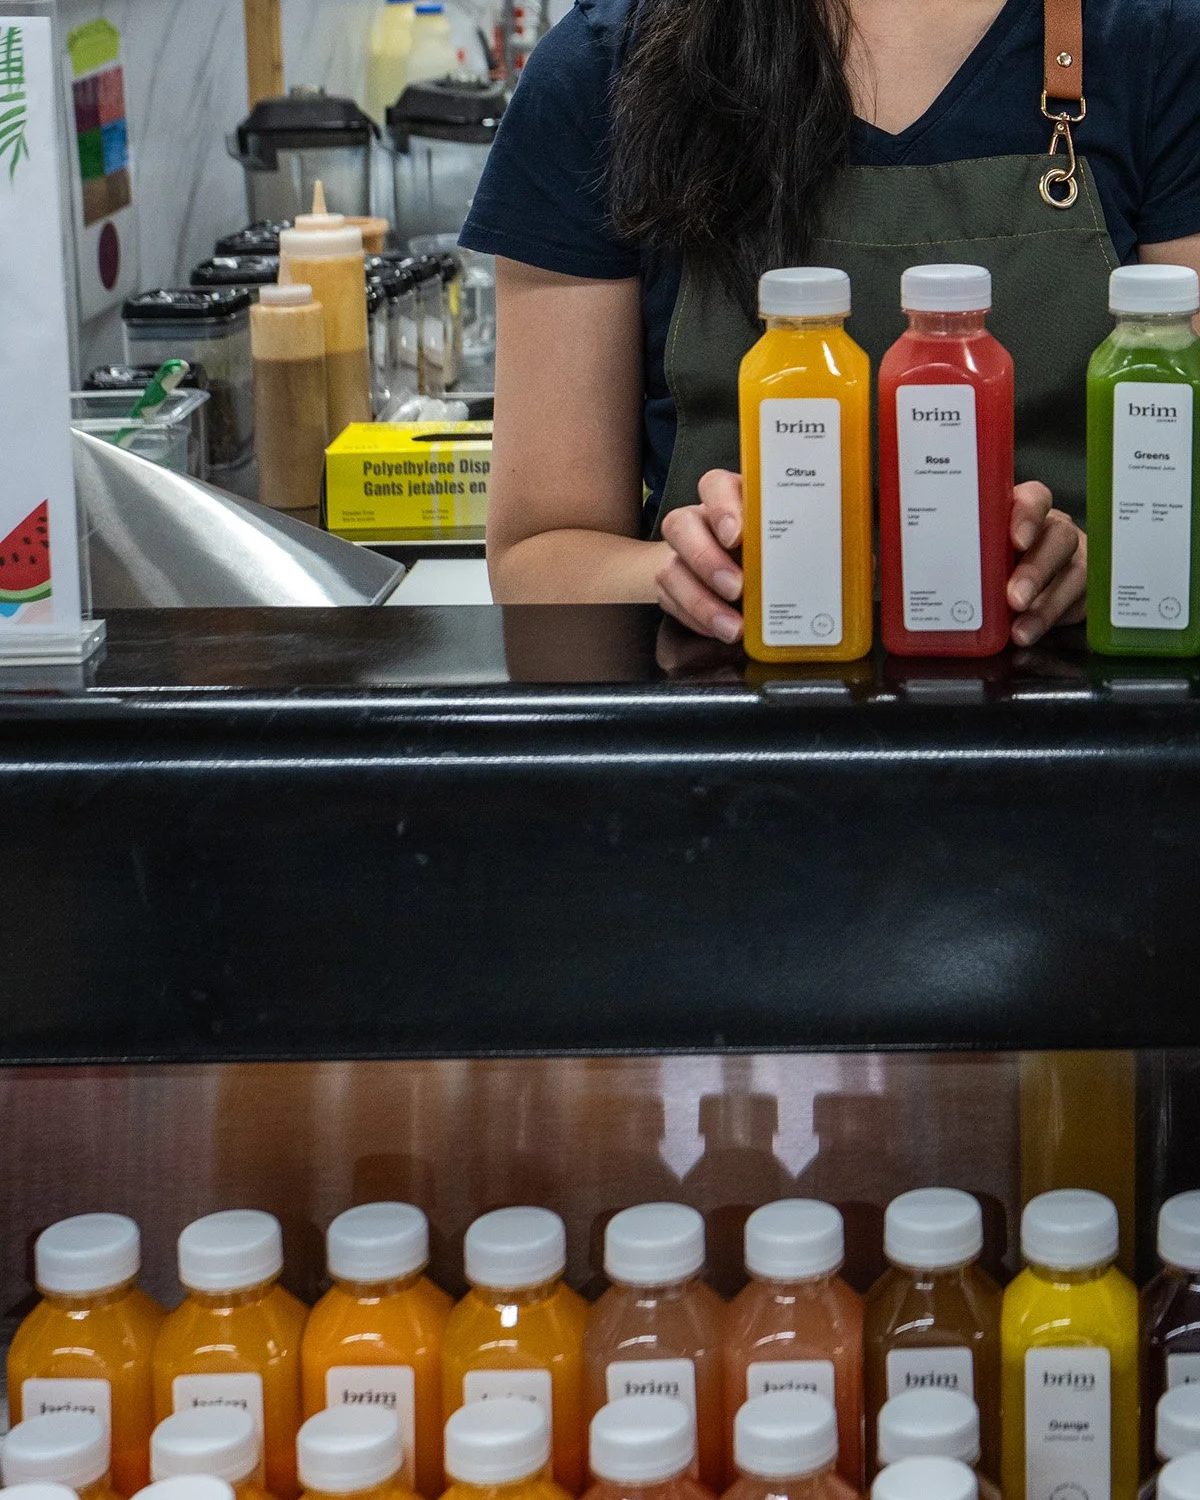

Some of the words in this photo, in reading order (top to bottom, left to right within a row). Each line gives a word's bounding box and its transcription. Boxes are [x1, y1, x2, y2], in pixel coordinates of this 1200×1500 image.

[911, 408, 960, 421] brim
[1129, 403, 1177, 417] brim
[776, 420, 825, 433] brim
[925, 455, 950, 464] Rose
[1134, 450, 1170, 460] Greens
[363, 460, 455, 477] Polyethylene
[460, 459, 491, 474] Disp
[785, 467, 816, 477] Citrus
[364, 481, 403, 497] Gants
[409, 480, 465, 497] jetables
[470, 482, 487, 494] en
[905, 1370, 959, 1388] brim
[1043, 1370, 1095, 1387] brim
[625, 1379, 680, 1397] brim
[342, 1389, 397, 1406] brim
[1048, 1419, 1089, 1432] Orange
